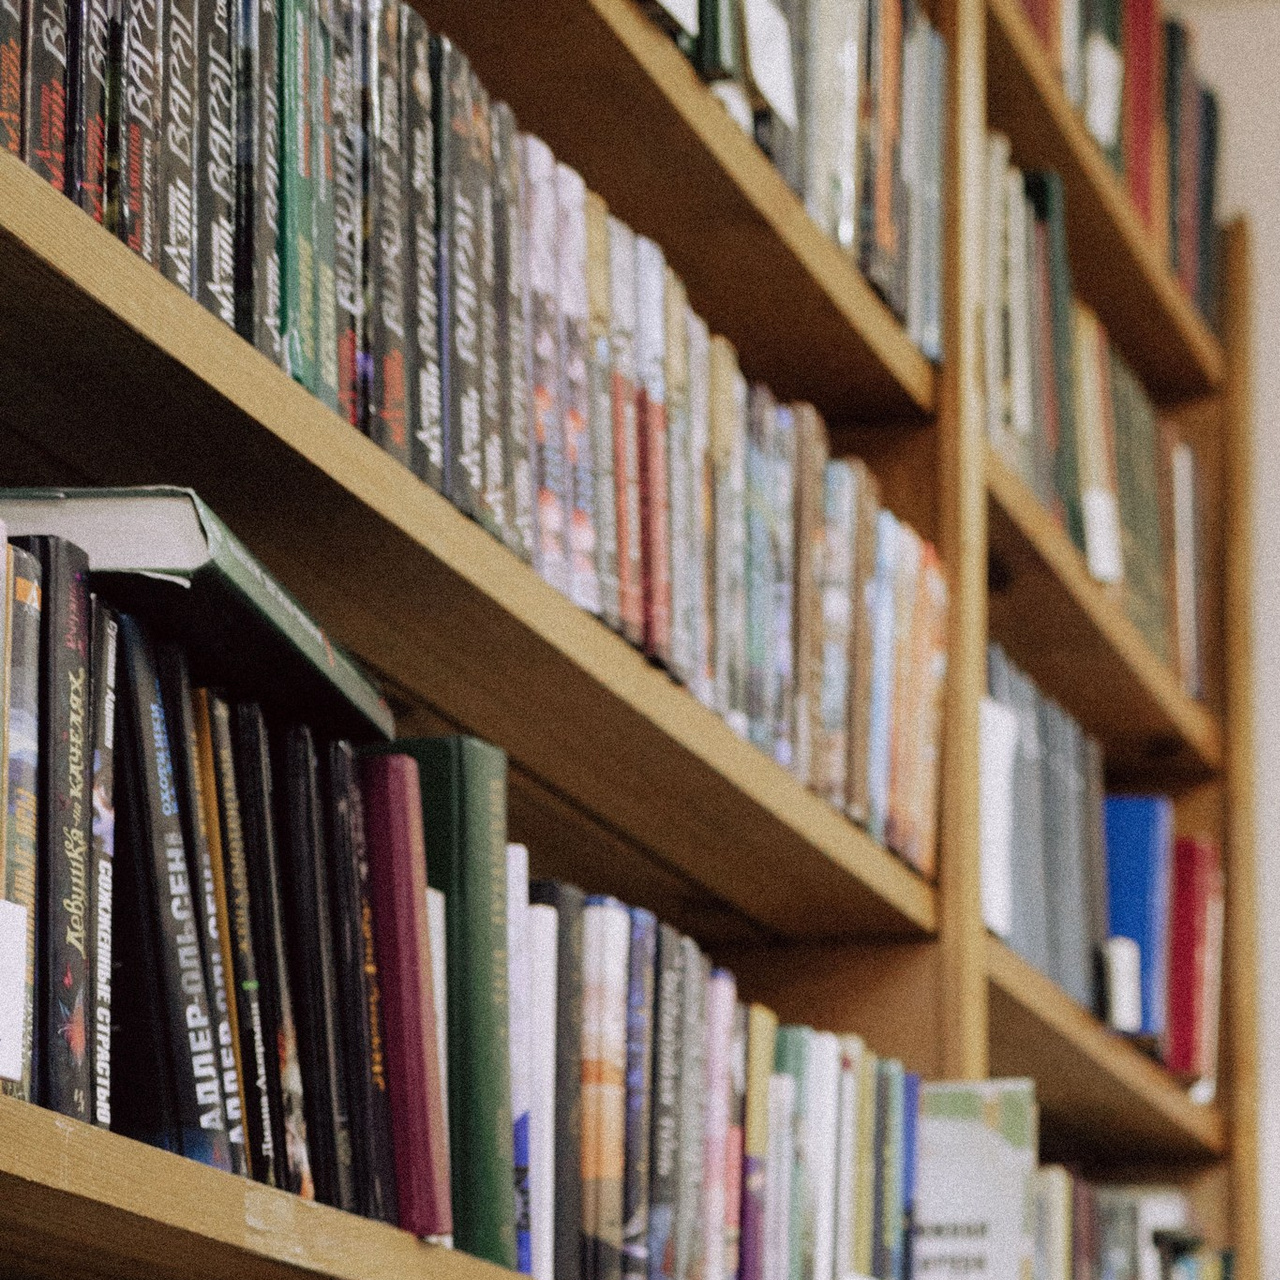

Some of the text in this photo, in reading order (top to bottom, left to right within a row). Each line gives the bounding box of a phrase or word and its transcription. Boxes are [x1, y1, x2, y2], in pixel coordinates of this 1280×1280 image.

[207, 32, 235, 203] ВАРЯГ
[95, 858, 114, 1126] СОЖЖЕННЫЕ СТРАСТЬЮ
